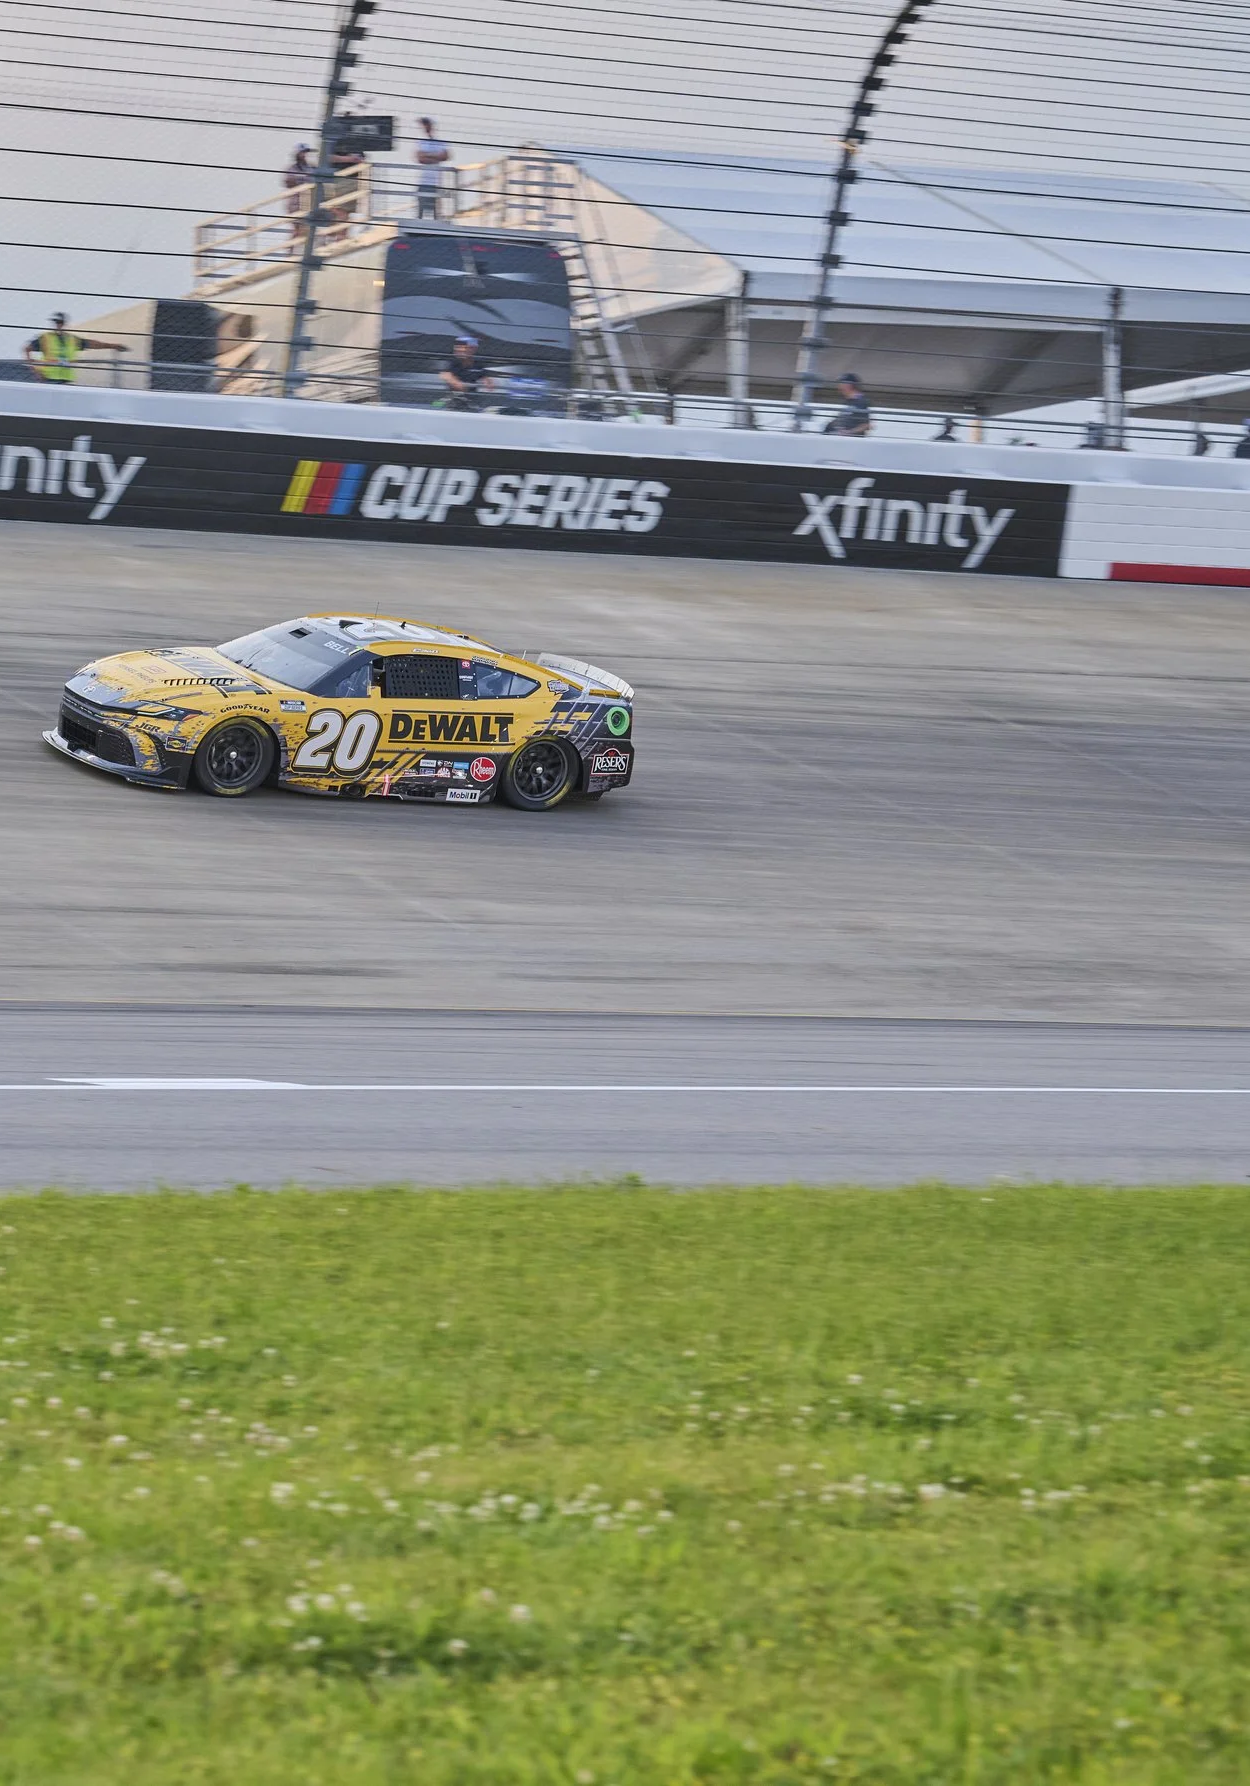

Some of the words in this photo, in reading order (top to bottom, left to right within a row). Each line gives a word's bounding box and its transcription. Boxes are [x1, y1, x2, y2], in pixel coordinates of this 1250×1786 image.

[359, 464, 479, 523] CUP
[476, 474, 671, 533] SERIES
[792, 478, 1016, 568] xfinity
[323, 640, 349, 655] BELL
[220, 704, 271, 714] GOODYEAR
[134, 722, 161, 733] JGR
[292, 709, 383, 773] 20
[472, 758, 494, 778] Rheem
[449, 791, 469, 799] Mobil
